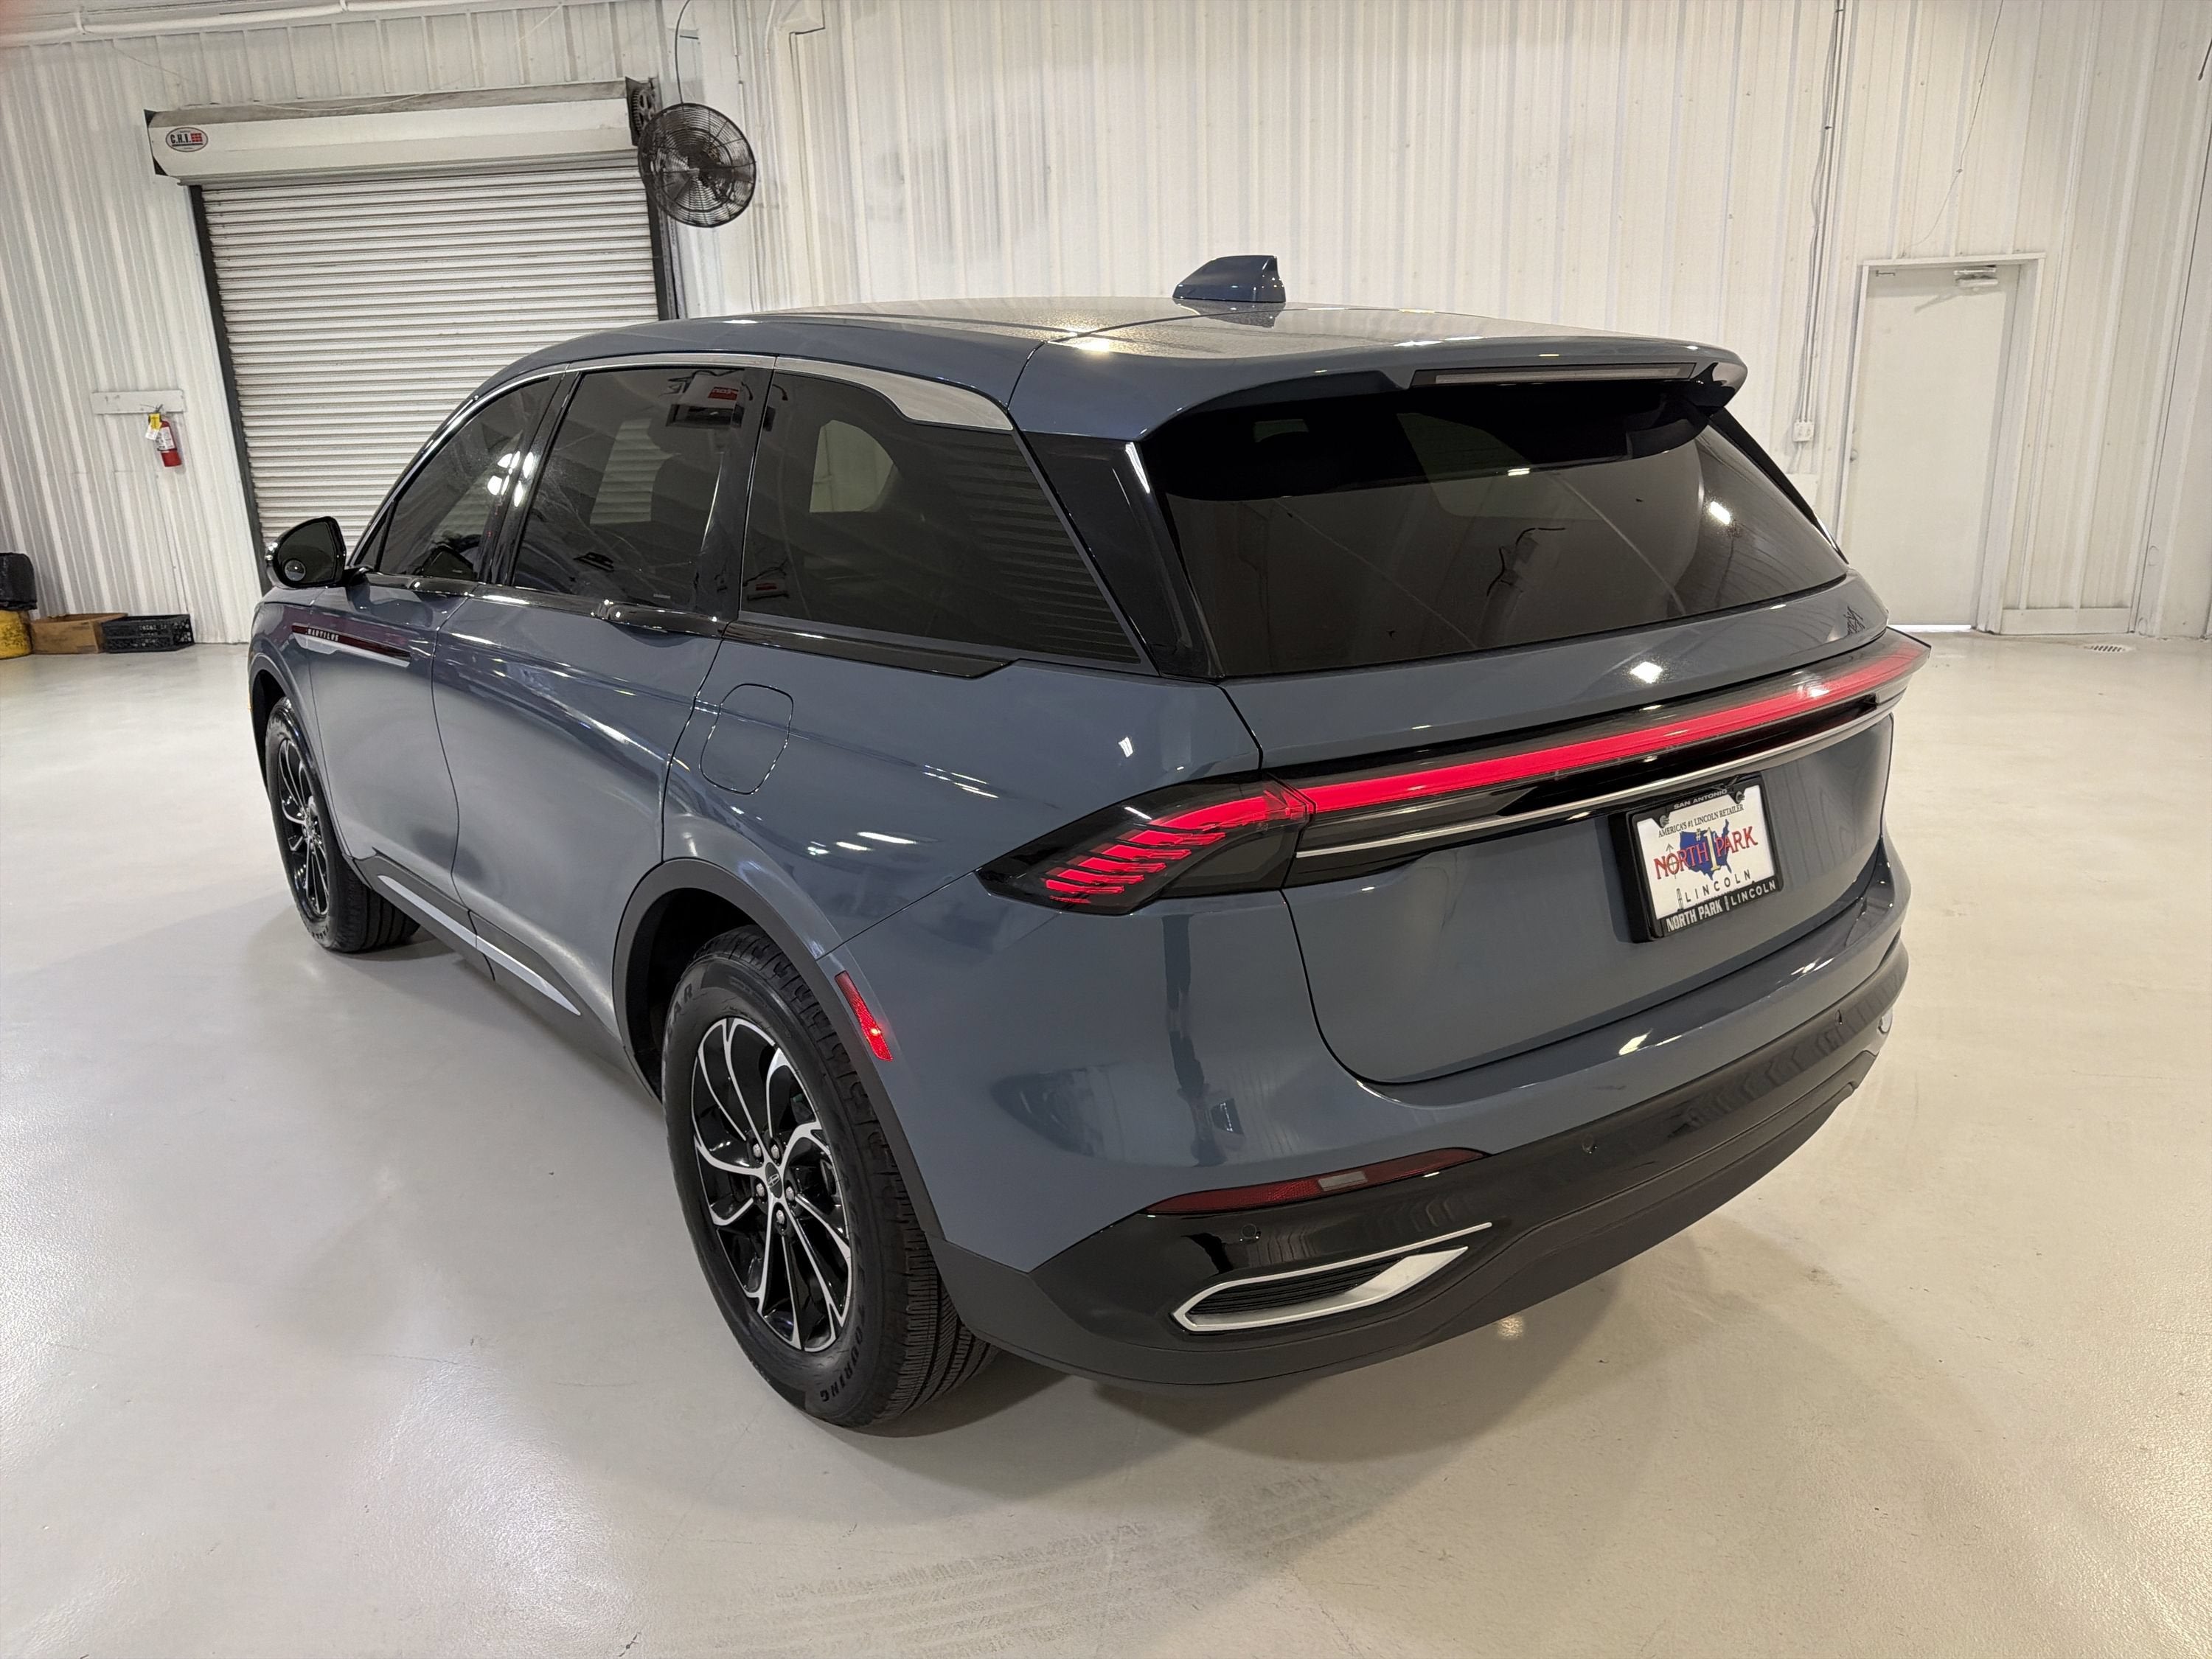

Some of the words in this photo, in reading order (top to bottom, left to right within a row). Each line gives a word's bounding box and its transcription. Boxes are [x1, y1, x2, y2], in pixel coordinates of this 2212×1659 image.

[170, 133, 191, 144] C.H.I.
[307, 628, 339, 641] NAUTILUS
[1673, 801, 1691, 810] SAN
[1693, 789, 1728, 804] ANTONIO
[1658, 820, 1687, 838] AMERICA'S
[1688, 818, 1694, 828] #1
[1694, 812, 1719, 826] LINCOLN
[1719, 804, 1745, 818] RETAILER
[1653, 841, 1710, 880] NORTH
[1716, 826, 1758, 858] PARK
[1685, 869, 1751, 902] LINCOLN
[1666, 908, 1697, 933] NORTH
[1697, 899, 1723, 920] PARK
[1731, 880, 1776, 905] LINCOLN
